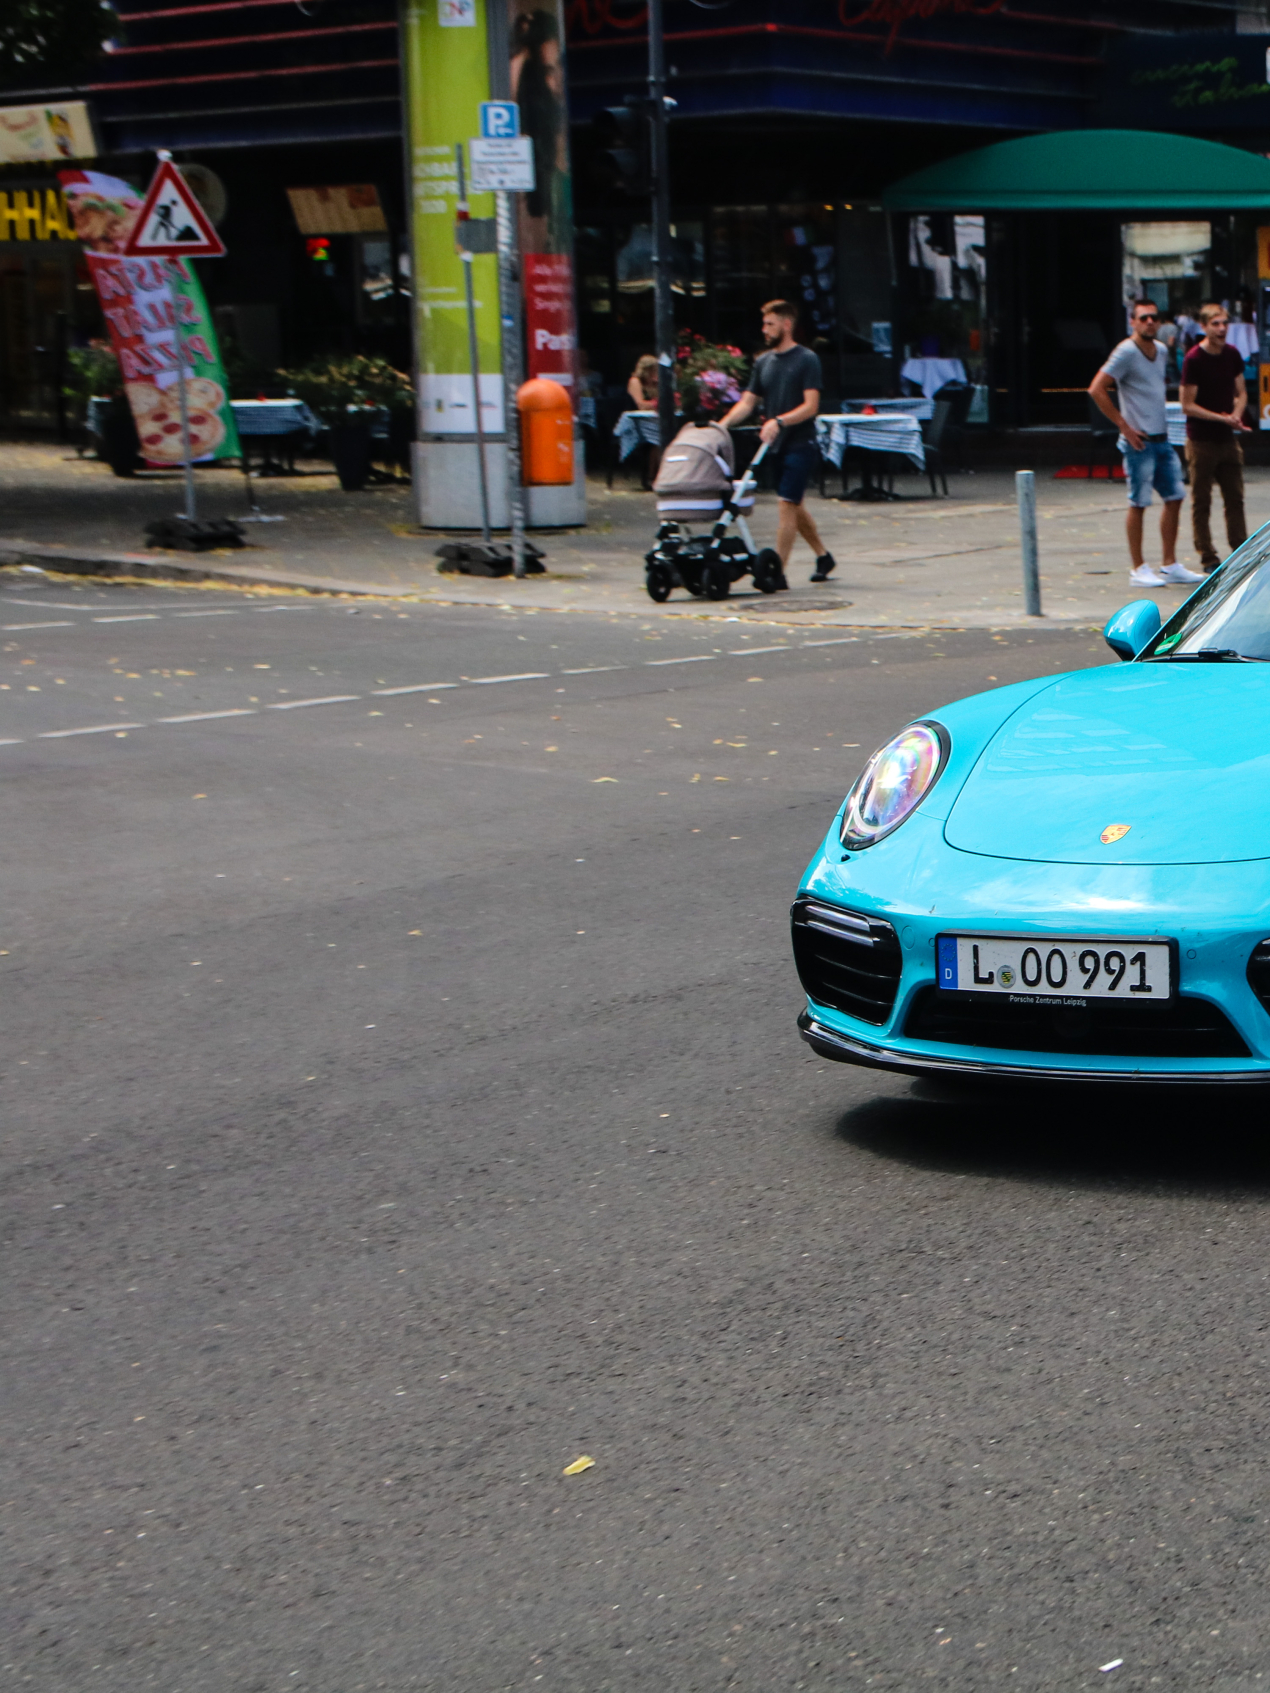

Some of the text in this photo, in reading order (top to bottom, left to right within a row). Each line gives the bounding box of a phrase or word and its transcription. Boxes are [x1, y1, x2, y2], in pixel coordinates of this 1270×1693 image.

[944, 967, 953, 980] D
[973, 944, 994, 985] L
[1078, 949, 1152, 993] 991
[1009, 994, 1087, 1007] Porsche Zentrum Leipzig
